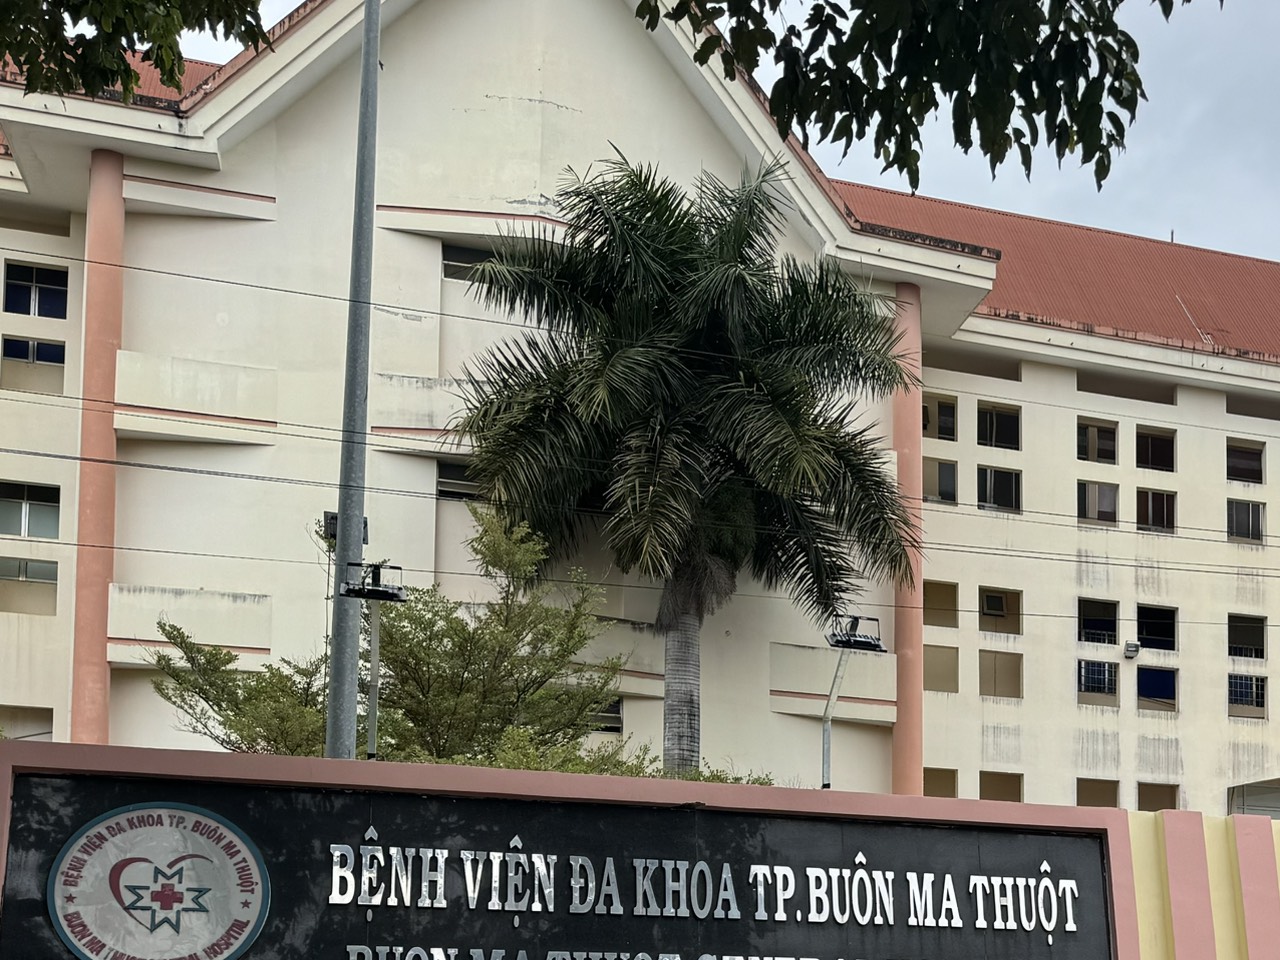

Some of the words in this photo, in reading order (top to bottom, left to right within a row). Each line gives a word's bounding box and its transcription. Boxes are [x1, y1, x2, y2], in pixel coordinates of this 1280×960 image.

[60, 856, 87, 888] BỆNH
[78, 831, 109, 857] VIỆN
[105, 822, 127, 838] ĐA
[126, 813, 165, 831] KHOA
[167, 813, 188, 831] TP.
[190, 820, 227, 845] BUÔN
[220, 837, 242, 860] MA
[234, 856, 259, 895] THUỘT
[328, 825, 449, 922] BỆNH
[460, 834, 558, 928] VIỆN
[569, 855, 624, 915] ĐA
[633, 857, 741, 919] KHOA
[906, 872, 963, 928] MA
[969, 860, 1080, 946] THUỘT
[63, 910, 93, 942] BUON
[83, 936, 107, 957] MA
[202, 918, 251, 960] HOSPITAL
